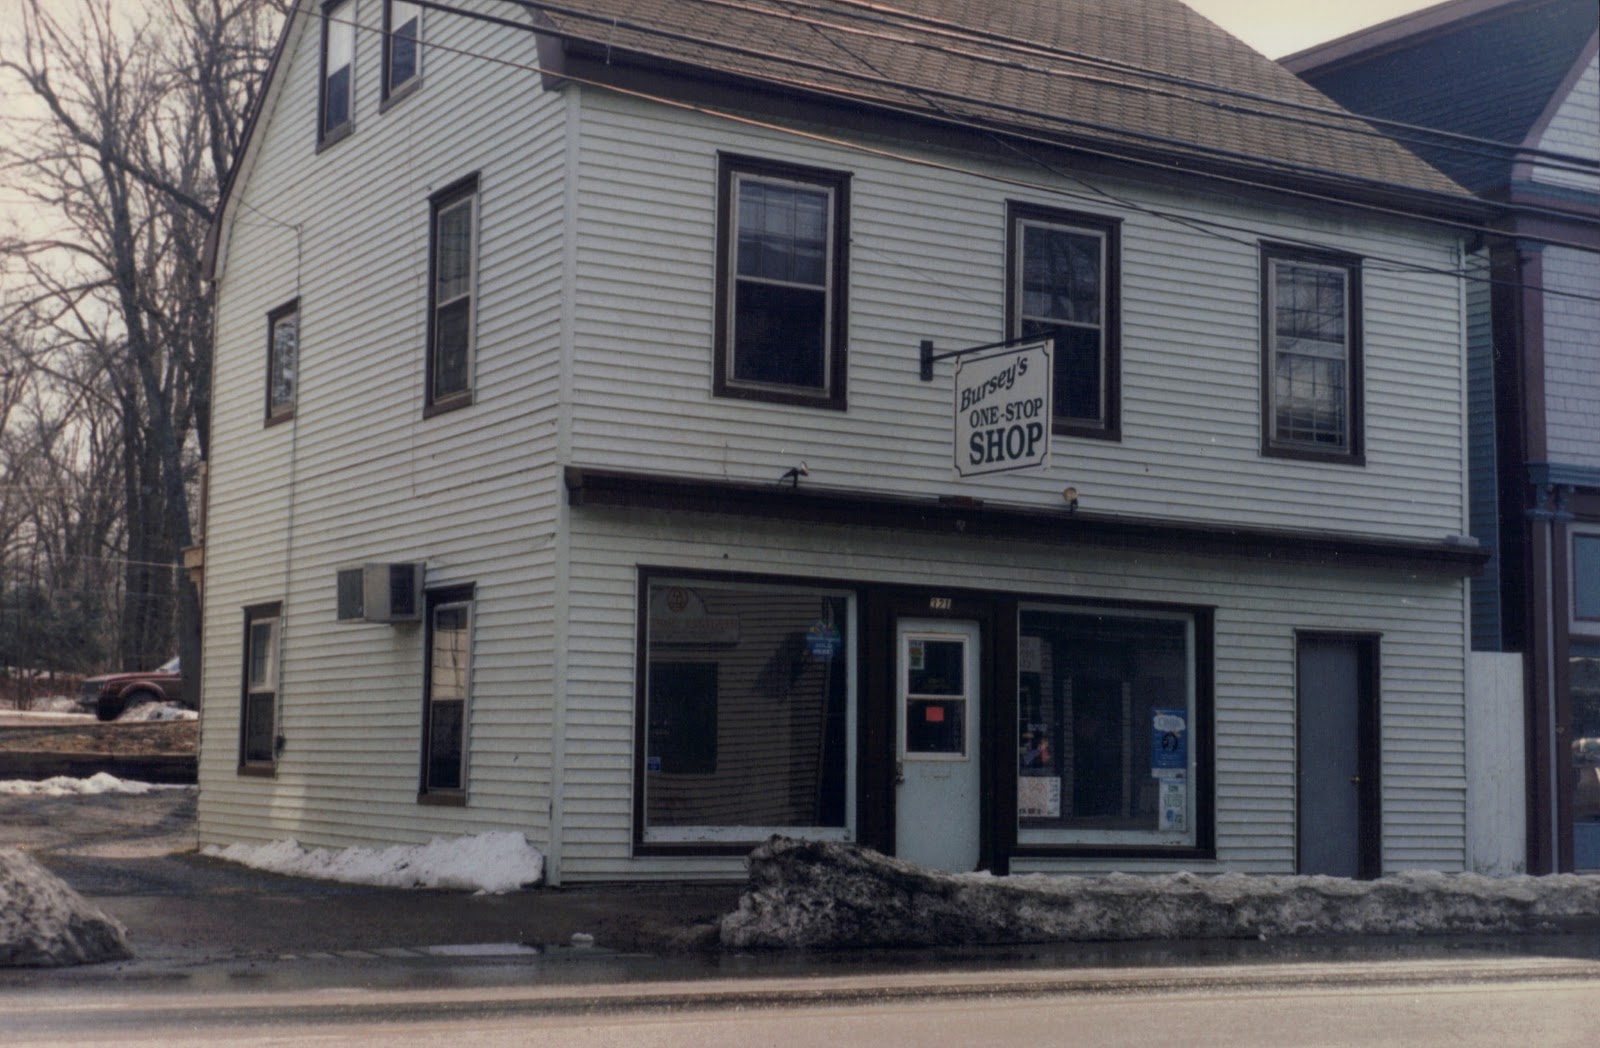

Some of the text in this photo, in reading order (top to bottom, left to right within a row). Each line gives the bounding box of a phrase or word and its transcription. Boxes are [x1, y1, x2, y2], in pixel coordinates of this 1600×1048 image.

[960, 356, 1028, 413] Bursey's
[969, 398, 1043, 428] ONE-STOP
[969, 422, 1043, 465] SHOP
